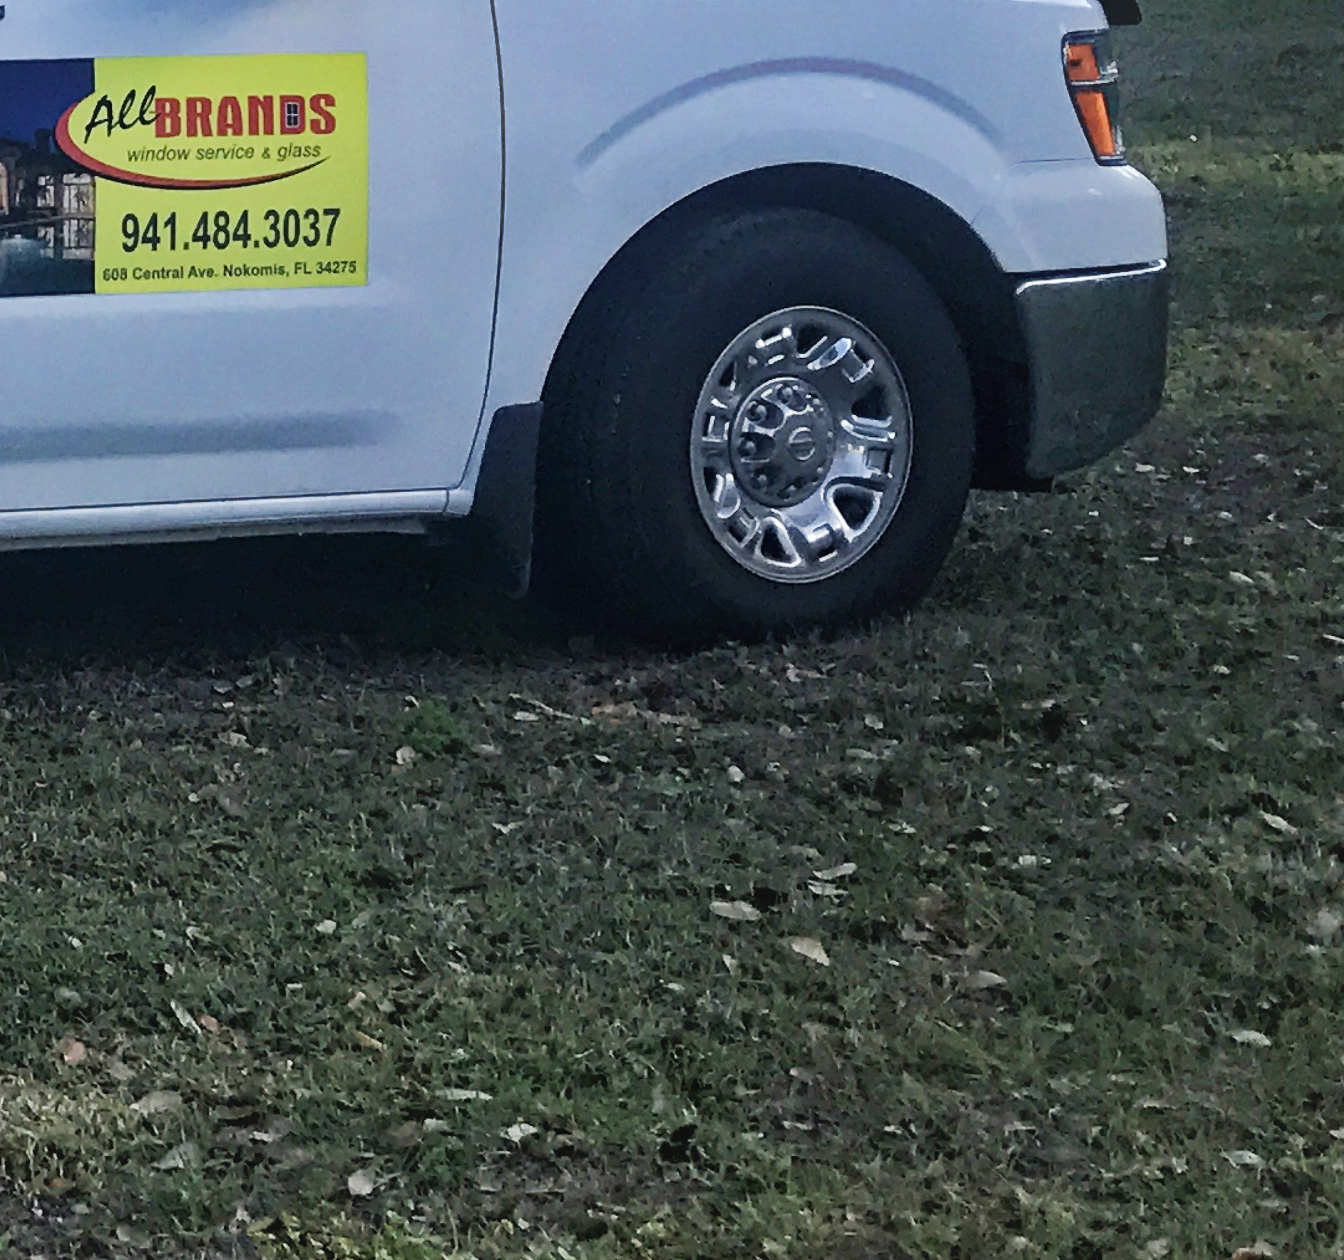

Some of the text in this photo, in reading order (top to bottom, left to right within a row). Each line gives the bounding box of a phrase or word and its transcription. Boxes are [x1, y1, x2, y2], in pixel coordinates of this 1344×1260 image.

[127, 143, 322, 163] window service & glass
[120, 207, 341, 254] 941.484.3037
[102, 261, 357, 282] 608 Central Ave. Nokomis, FL 34275
